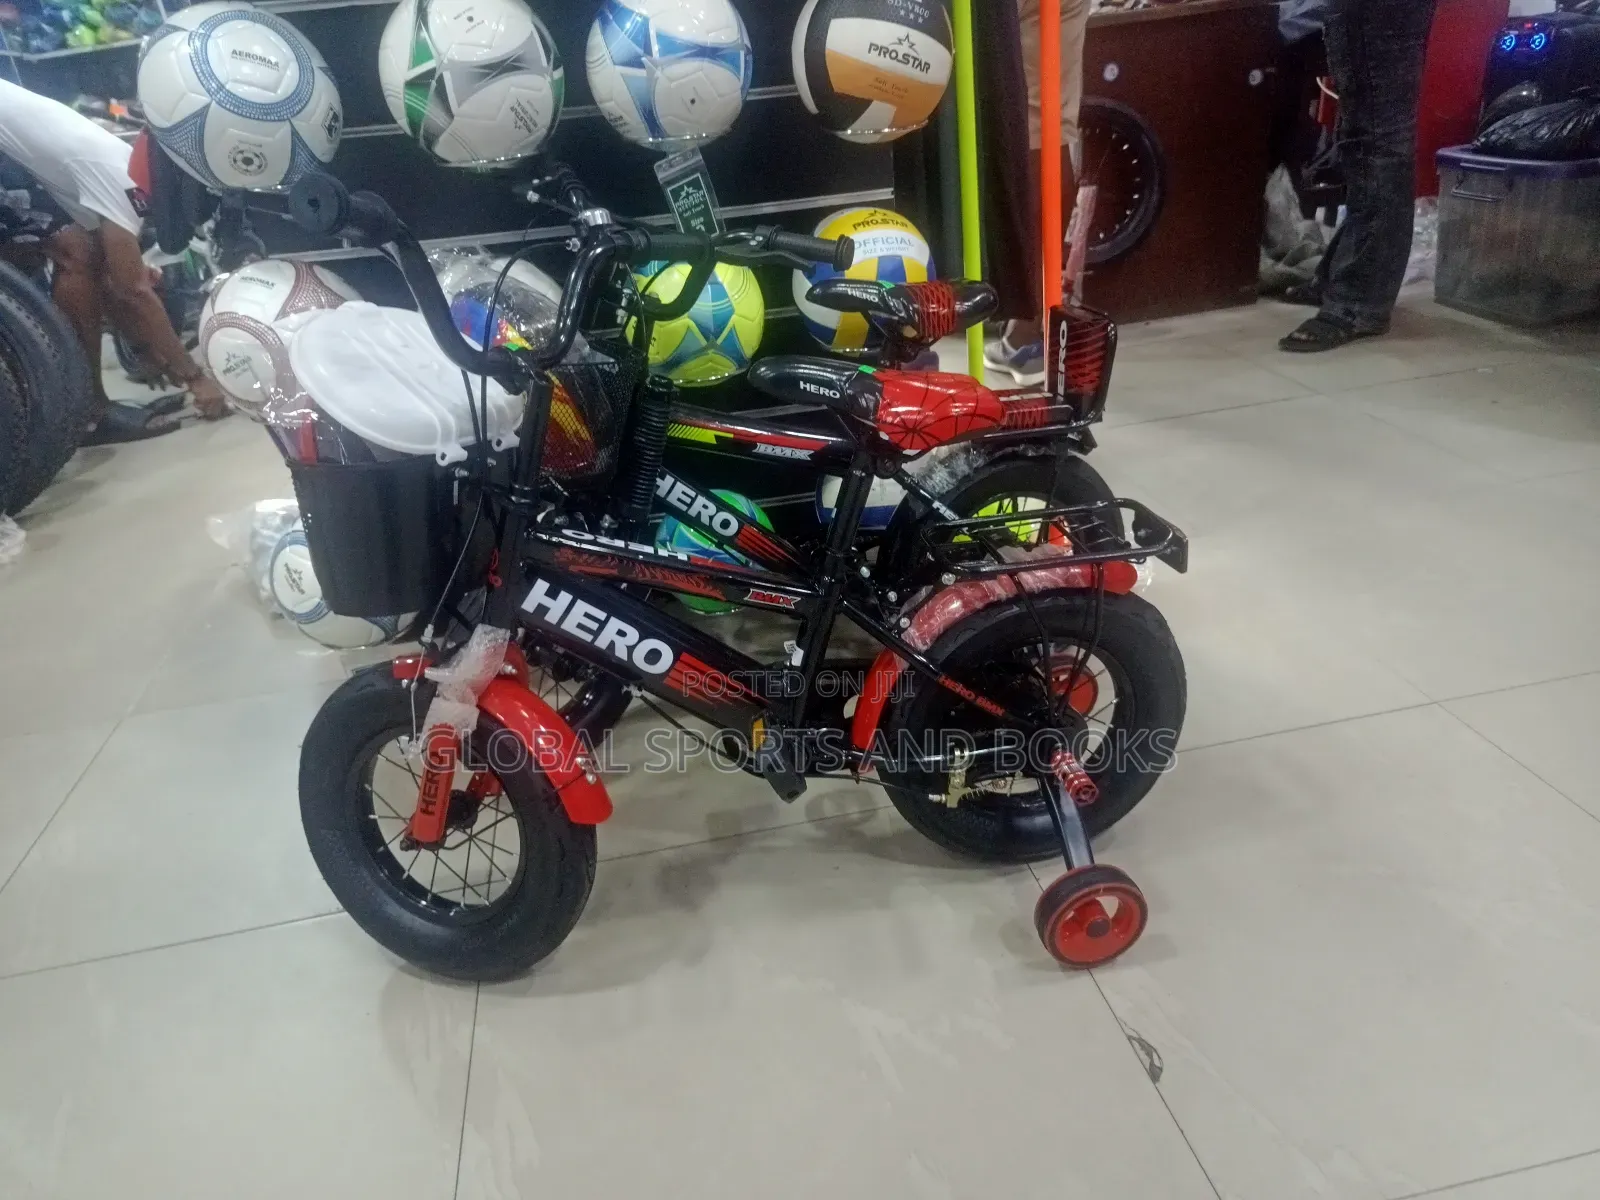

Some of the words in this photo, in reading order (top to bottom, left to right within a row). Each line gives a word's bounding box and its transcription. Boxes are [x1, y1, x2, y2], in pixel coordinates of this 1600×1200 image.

[231, 49, 280, 68] AEROMAX
[847, 288, 878, 303] HERO
[799, 380, 841, 399] HERO
[744, 588, 801, 609] BMX
[521, 578, 674, 674] HERO
[937, 675, 976, 700] HERO
[975, 696, 1006, 717] BMX
